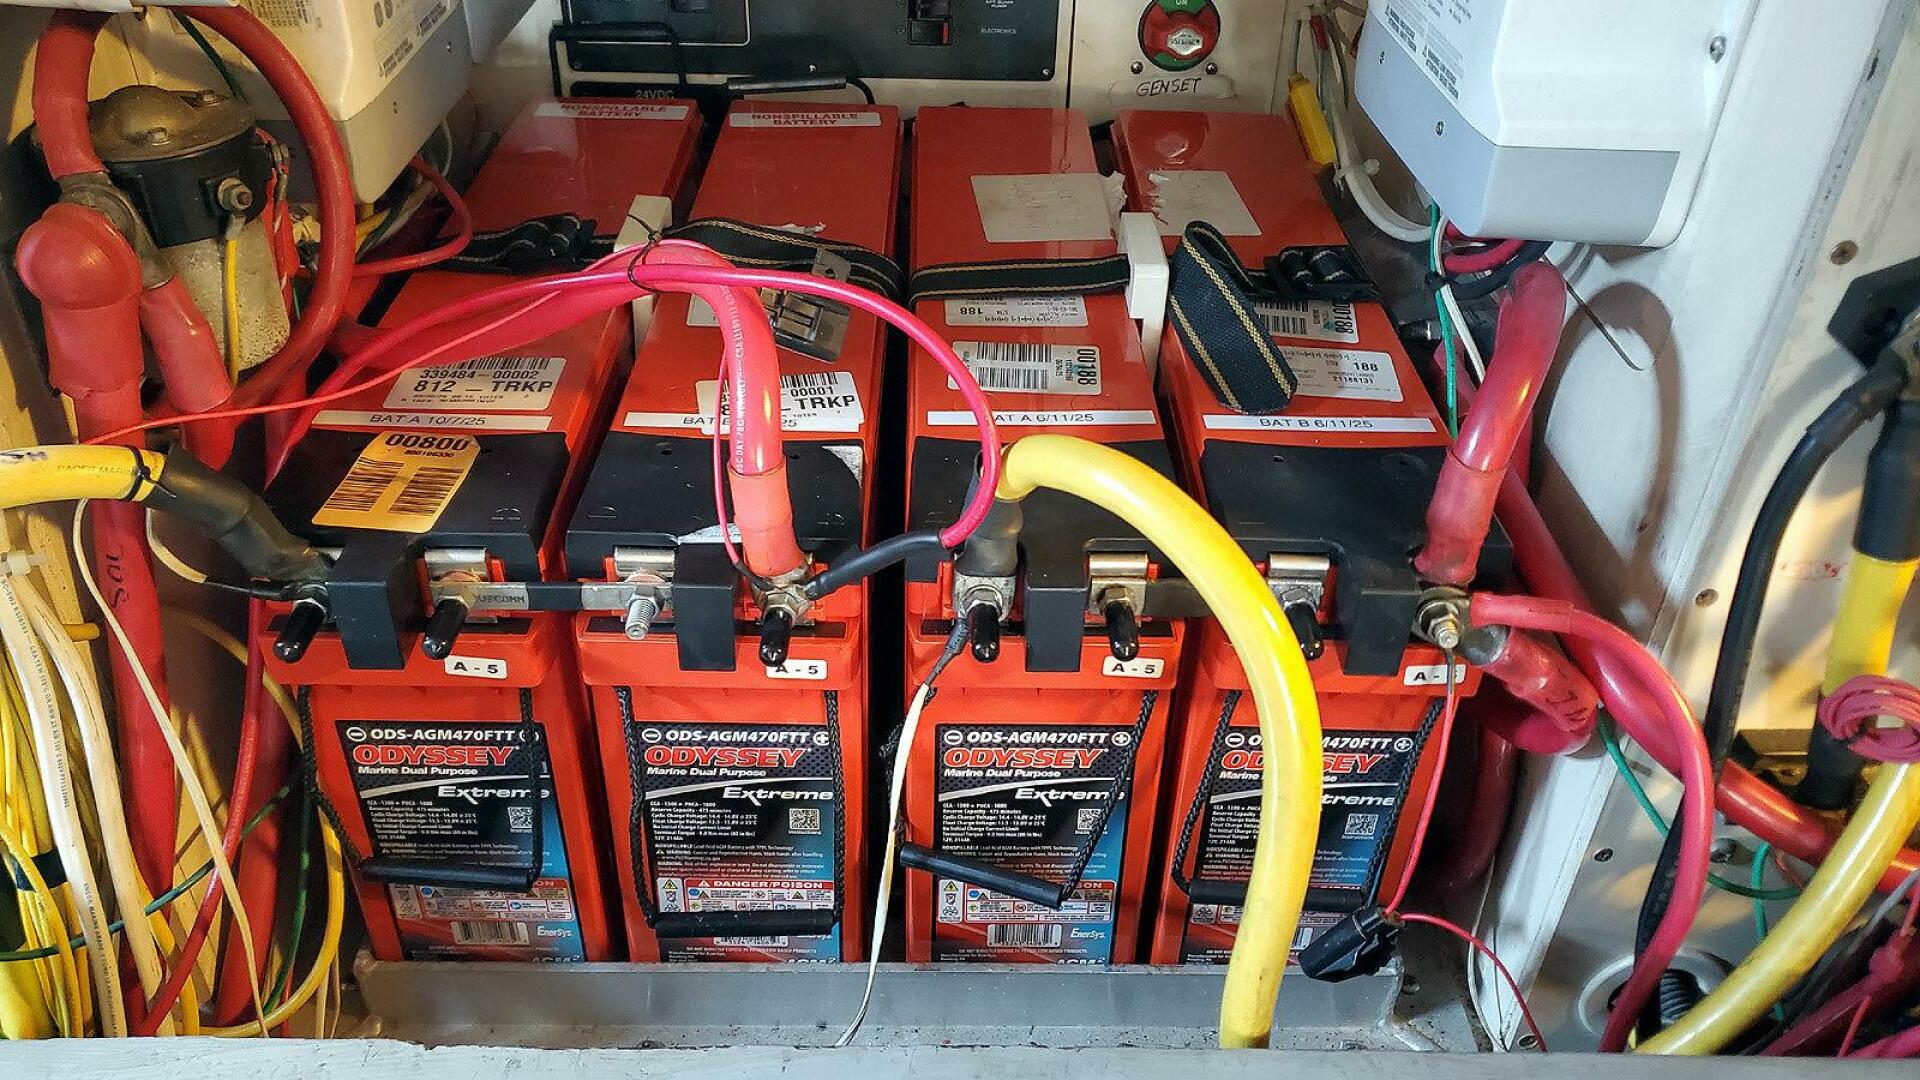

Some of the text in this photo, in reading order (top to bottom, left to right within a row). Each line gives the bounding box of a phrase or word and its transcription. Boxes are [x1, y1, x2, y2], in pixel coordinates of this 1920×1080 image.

[1136, 78, 1202, 97] GENSET
[635, 89, 674, 100] 24VDC
[561, 103, 666, 113] NONSPILLABLE
[577, 109, 643, 118] BATTERY
[959, 306, 984, 316] 188
[1077, 348, 1098, 387] 00188
[1353, 361, 1379, 372] 188
[413, 380, 553, 393] 812 TRKP
[794, 395, 856, 410] TRKP
[369, 414, 488, 427] BAT A 10/7/25
[683, 417, 716, 425] BAT
[994, 414, 1095, 422] AT A 6/11/25
[1259, 418, 1374, 429] BAT B 6/11/25
[384, 433, 472, 451] 00800
[370, 728, 516, 742] ODS-AGM470FTT
[665, 730, 811, 743] ODS-AGM470FTT
[966, 732, 1109, 744] ODS-AGM470FTT
[353, 744, 513, 766] ODYSSEY
[645, 746, 806, 768] ODYSSEY
[943, 748, 1104, 769] ODYSSEY
[358, 766, 479, 776] Marine Dual Purpose
[646, 767, 767, 778] Marine Dual Purpose
[943, 769, 1061, 779] Marine Dual Purpose
[1219, 771, 1259, 781] Marine
[722, 786, 834, 806] Extreme
[713, 880, 823, 889] DANGER/POISON
[537, 925, 573, 937] EnerSys
[1070, 928, 1106, 939] EnerSys
